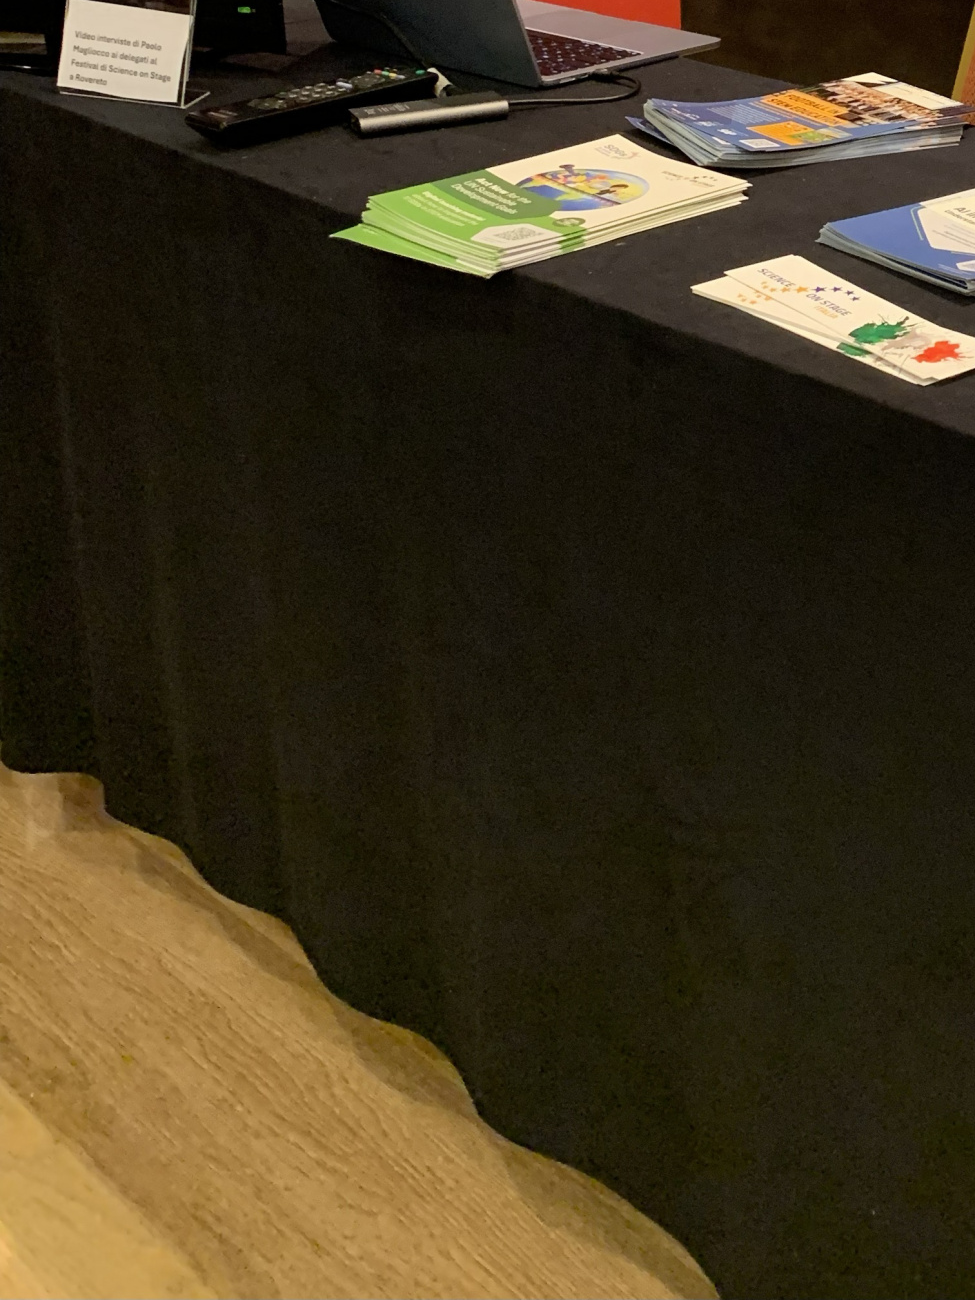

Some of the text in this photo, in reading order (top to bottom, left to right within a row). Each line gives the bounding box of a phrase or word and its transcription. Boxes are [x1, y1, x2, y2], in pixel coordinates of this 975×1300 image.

[75, 30, 96, 41] Video
[96, 35, 131, 47] interviste
[141, 40, 162, 51] Paolo
[73, 45, 110, 58] Magliocco
[111, 51, 118, 59] ai
[118, 52, 149, 64] delegati
[71, 59, 98, 70] Festival
[100, 63, 107, 72] di
[108, 64, 138, 77] Science
[150, 71, 171, 83] Stage
[75, 73, 107, 86] Rovereto
[758, 268, 852, 316] SCIENCE ON STAGE
